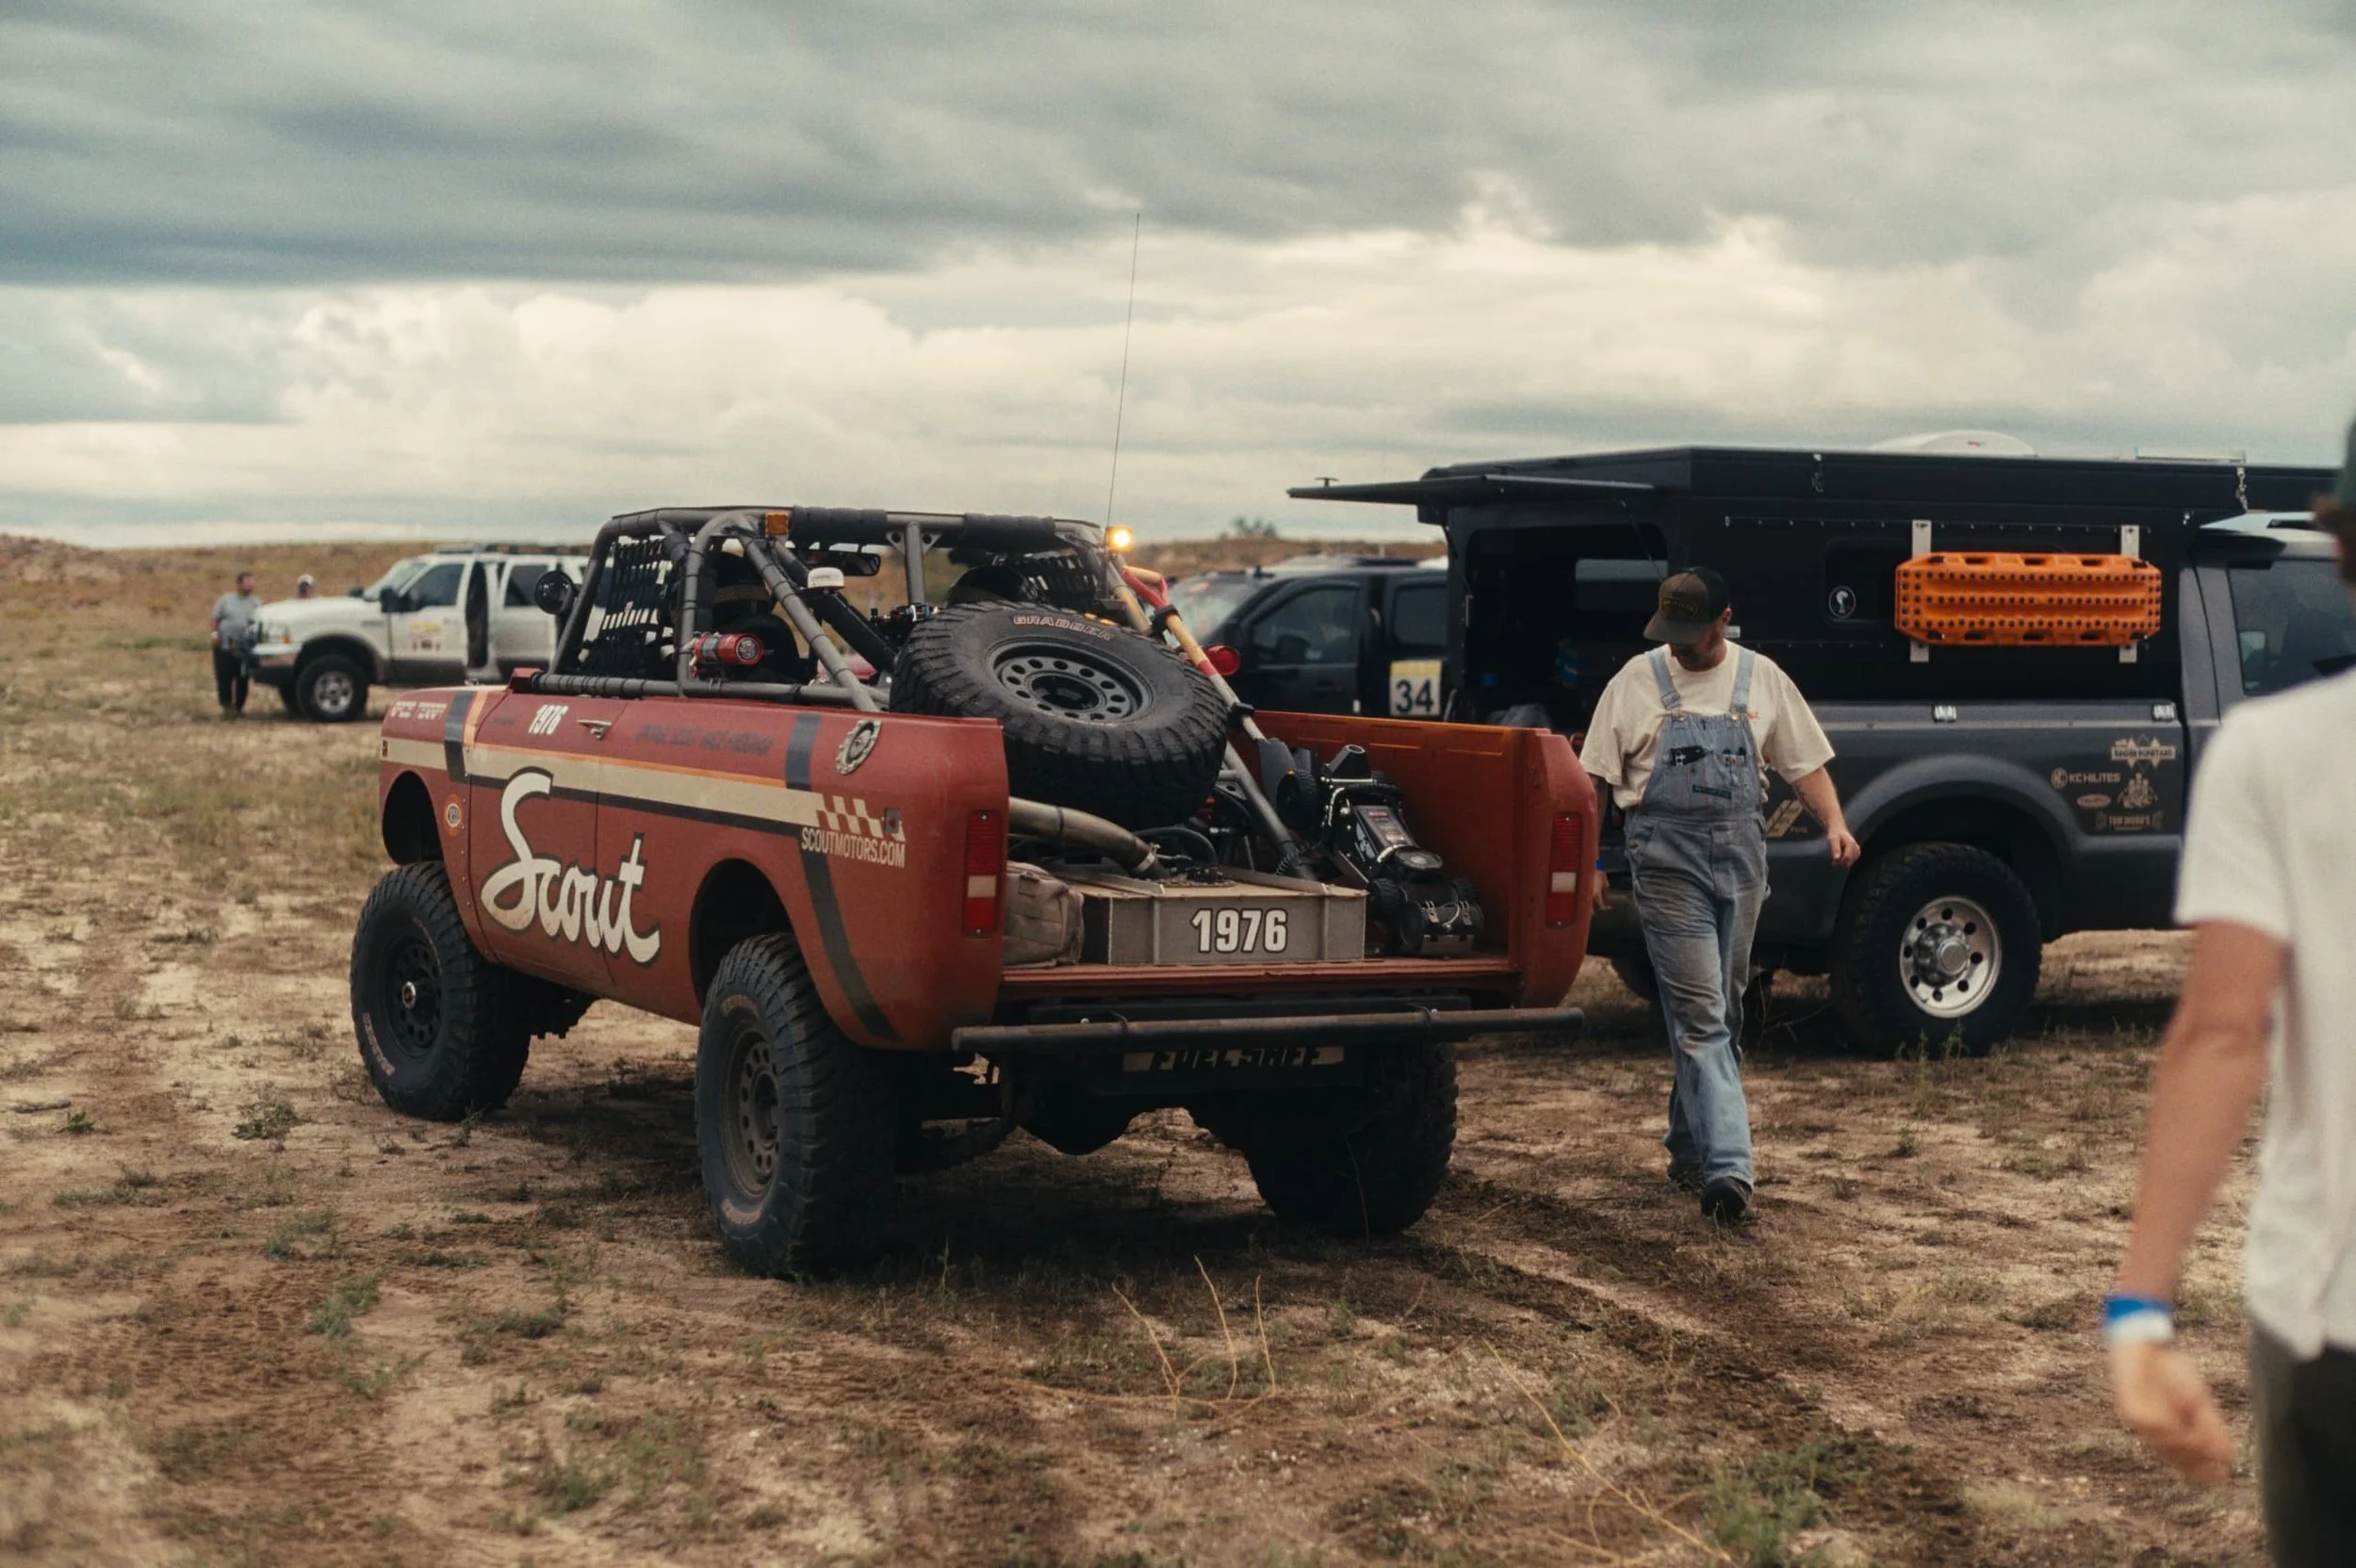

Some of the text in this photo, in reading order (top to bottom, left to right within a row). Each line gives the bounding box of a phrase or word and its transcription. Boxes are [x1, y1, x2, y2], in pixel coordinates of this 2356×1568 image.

[1396, 678, 1434, 713] 34
[528, 704, 569, 736] 1976
[480, 768, 660, 965] Scout
[801, 826, 907, 869] SCOUTMOTORS.COM
[1190, 907, 1288, 954] 1976
